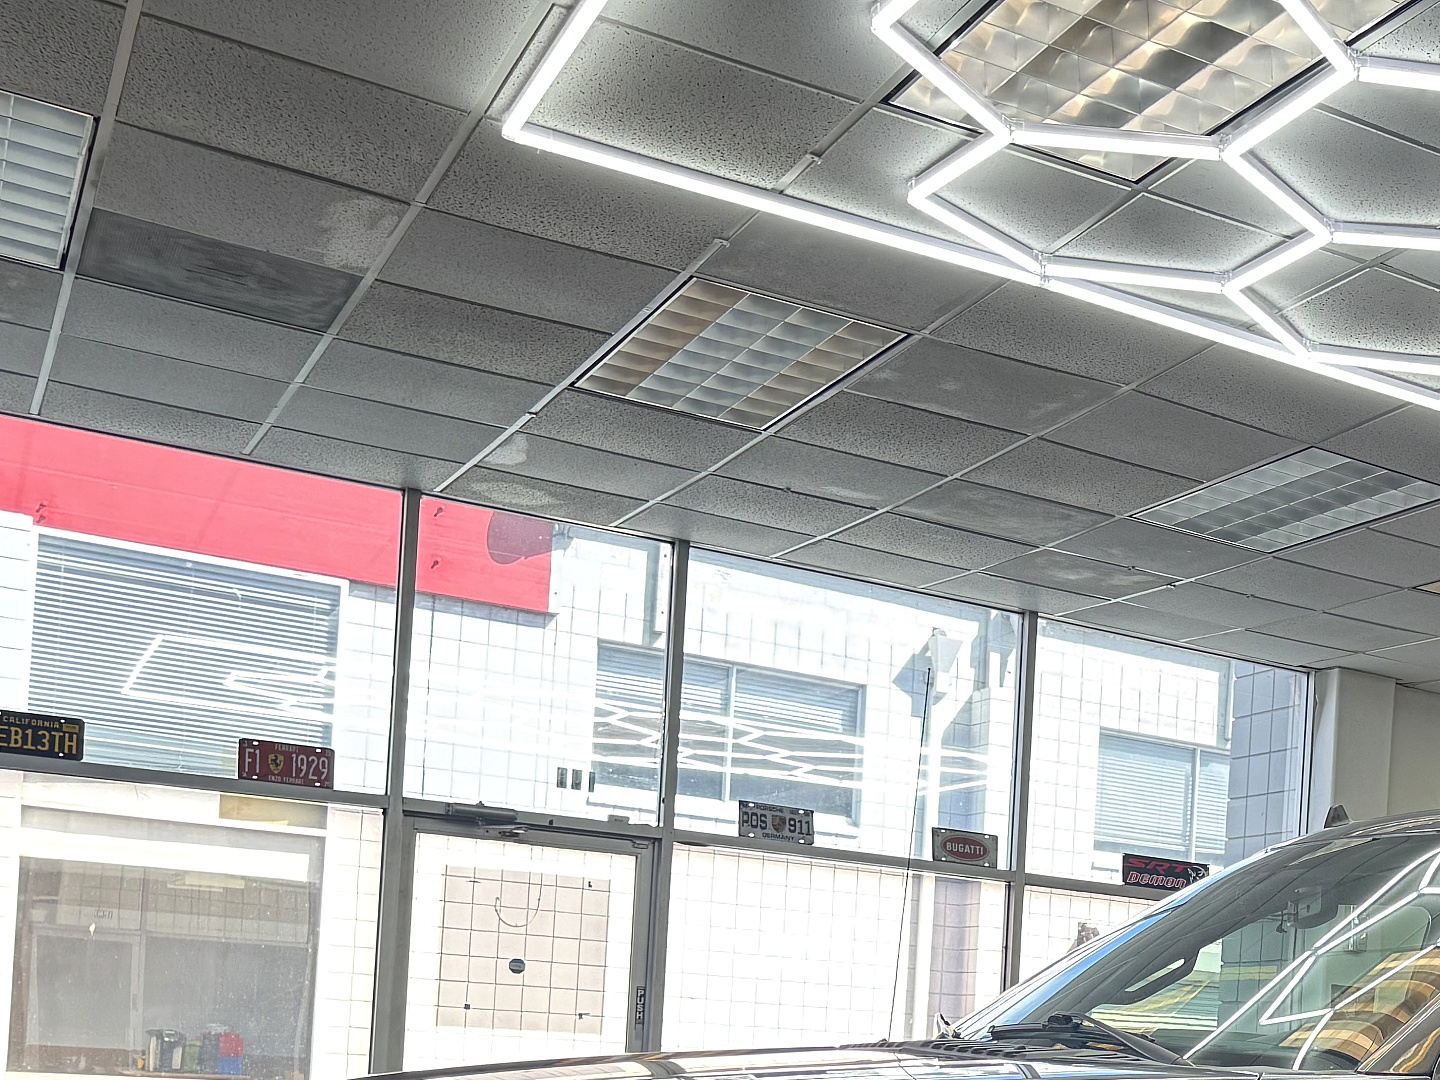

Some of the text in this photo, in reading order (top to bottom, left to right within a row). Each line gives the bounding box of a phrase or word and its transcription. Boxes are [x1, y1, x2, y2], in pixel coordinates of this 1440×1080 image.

[3, 715, 60, 729] CALIFORNIA
[244, 748, 328, 780] F1 1929
[756, 804, 785, 814] PORSCHE
[788, 817, 812, 836] 911
[762, 832, 795, 841] GERMANY
[946, 842, 984, 855] BUGATTI
[1125, 857, 1192, 875] SRT
[636, 989, 645, 1020] PUSH
